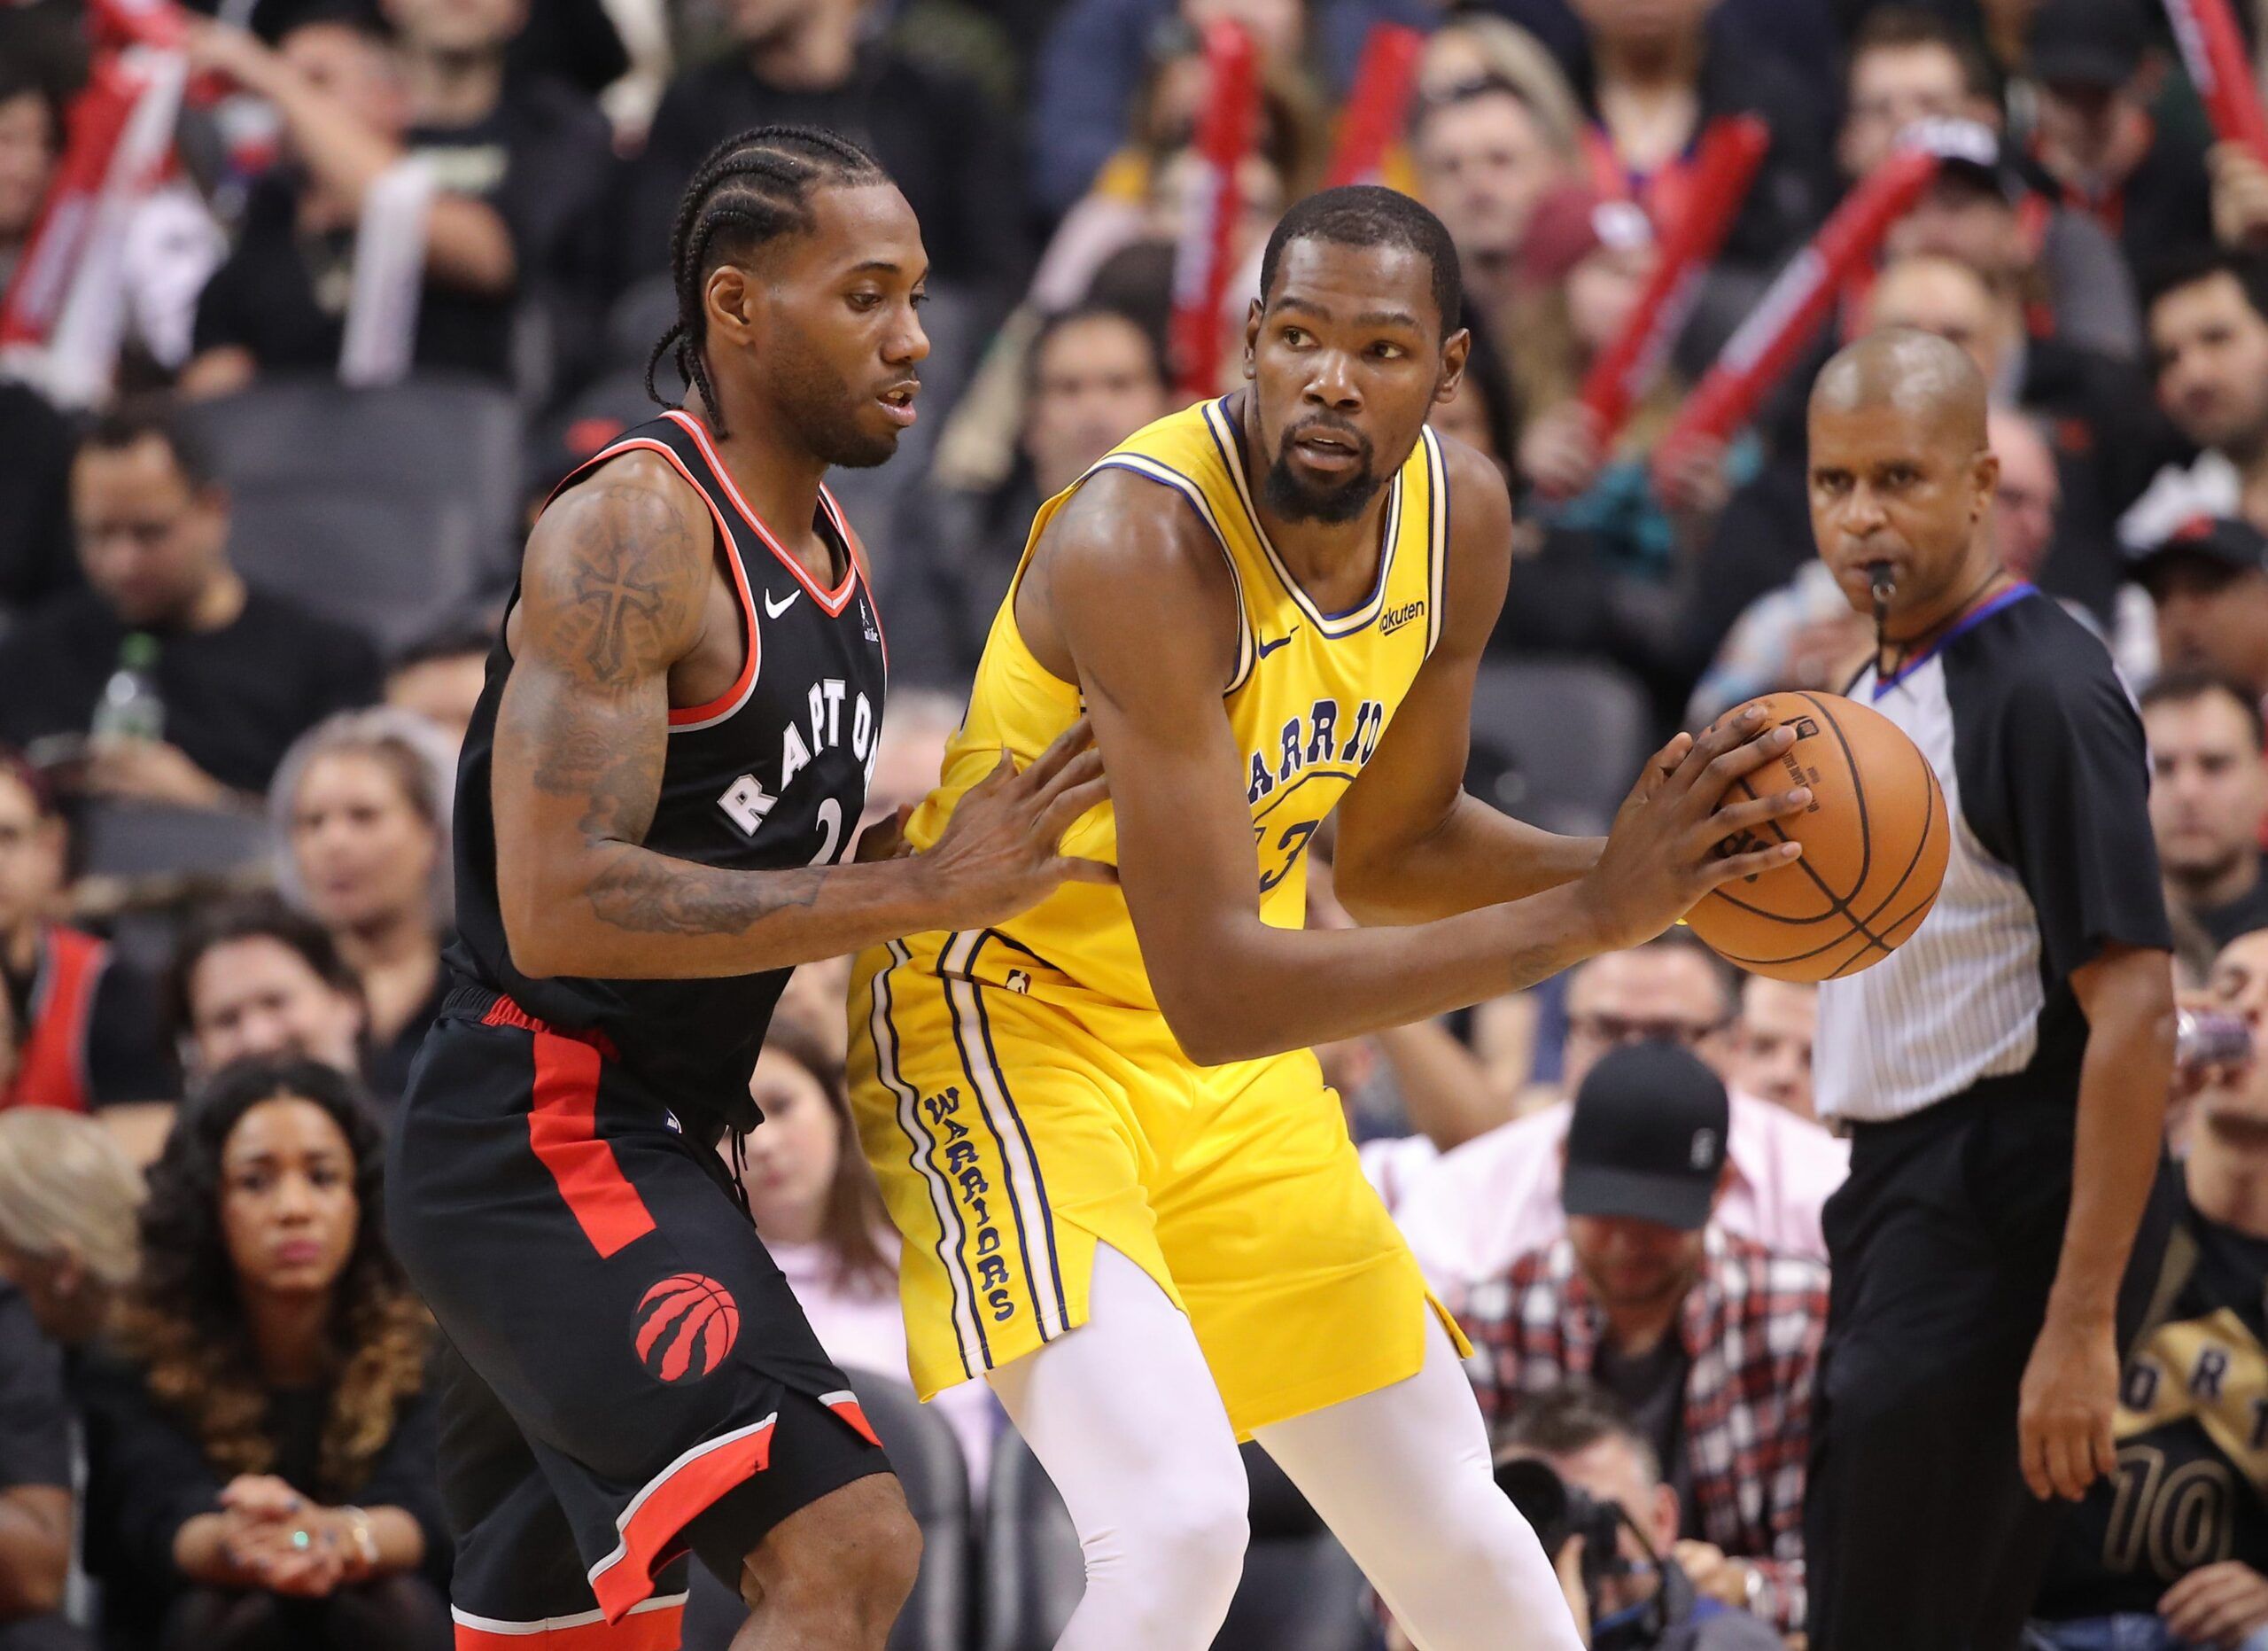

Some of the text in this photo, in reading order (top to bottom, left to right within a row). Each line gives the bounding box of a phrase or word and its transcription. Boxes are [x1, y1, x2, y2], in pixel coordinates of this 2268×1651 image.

[1379, 600, 1425, 633] akuten
[925, 1086, 1015, 1321] WARRIORS
[2101, 1444, 2233, 1583] 10
